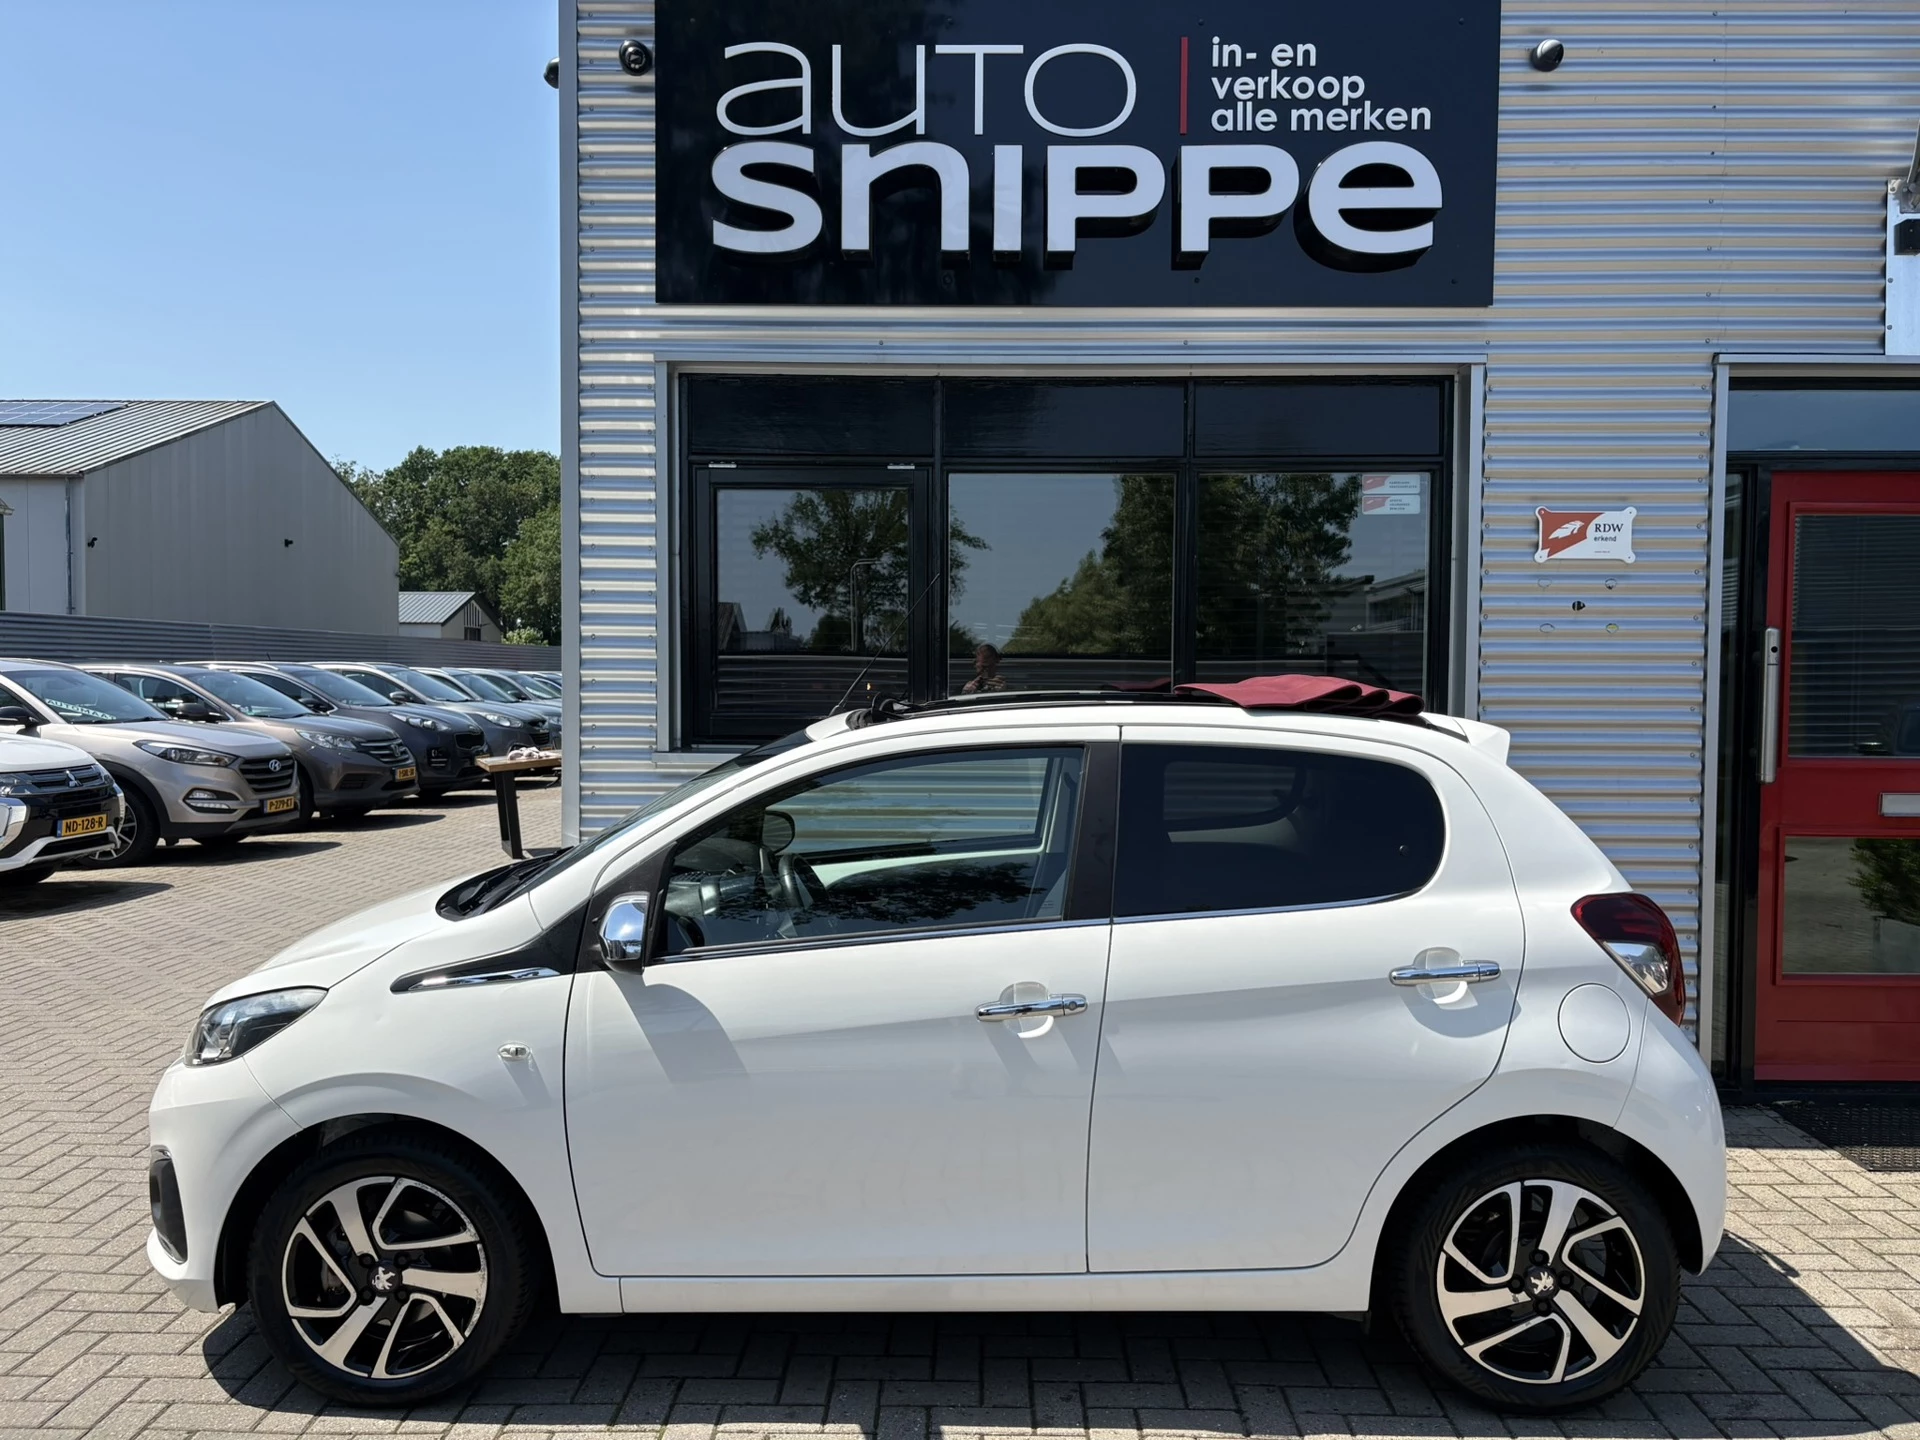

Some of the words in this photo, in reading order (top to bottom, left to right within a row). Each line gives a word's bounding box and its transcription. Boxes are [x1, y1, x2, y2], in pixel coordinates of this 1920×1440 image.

[1212, 36, 1257, 67] in-
[1271, 43, 1317, 67] en
[1212, 68, 1365, 106] verkoop
[1211, 101, 1278, 132] alle
[1290, 100, 1431, 131] merken
[1594, 523, 1624, 533] RDW
[65, 816, 104, 833] ND-128-R
